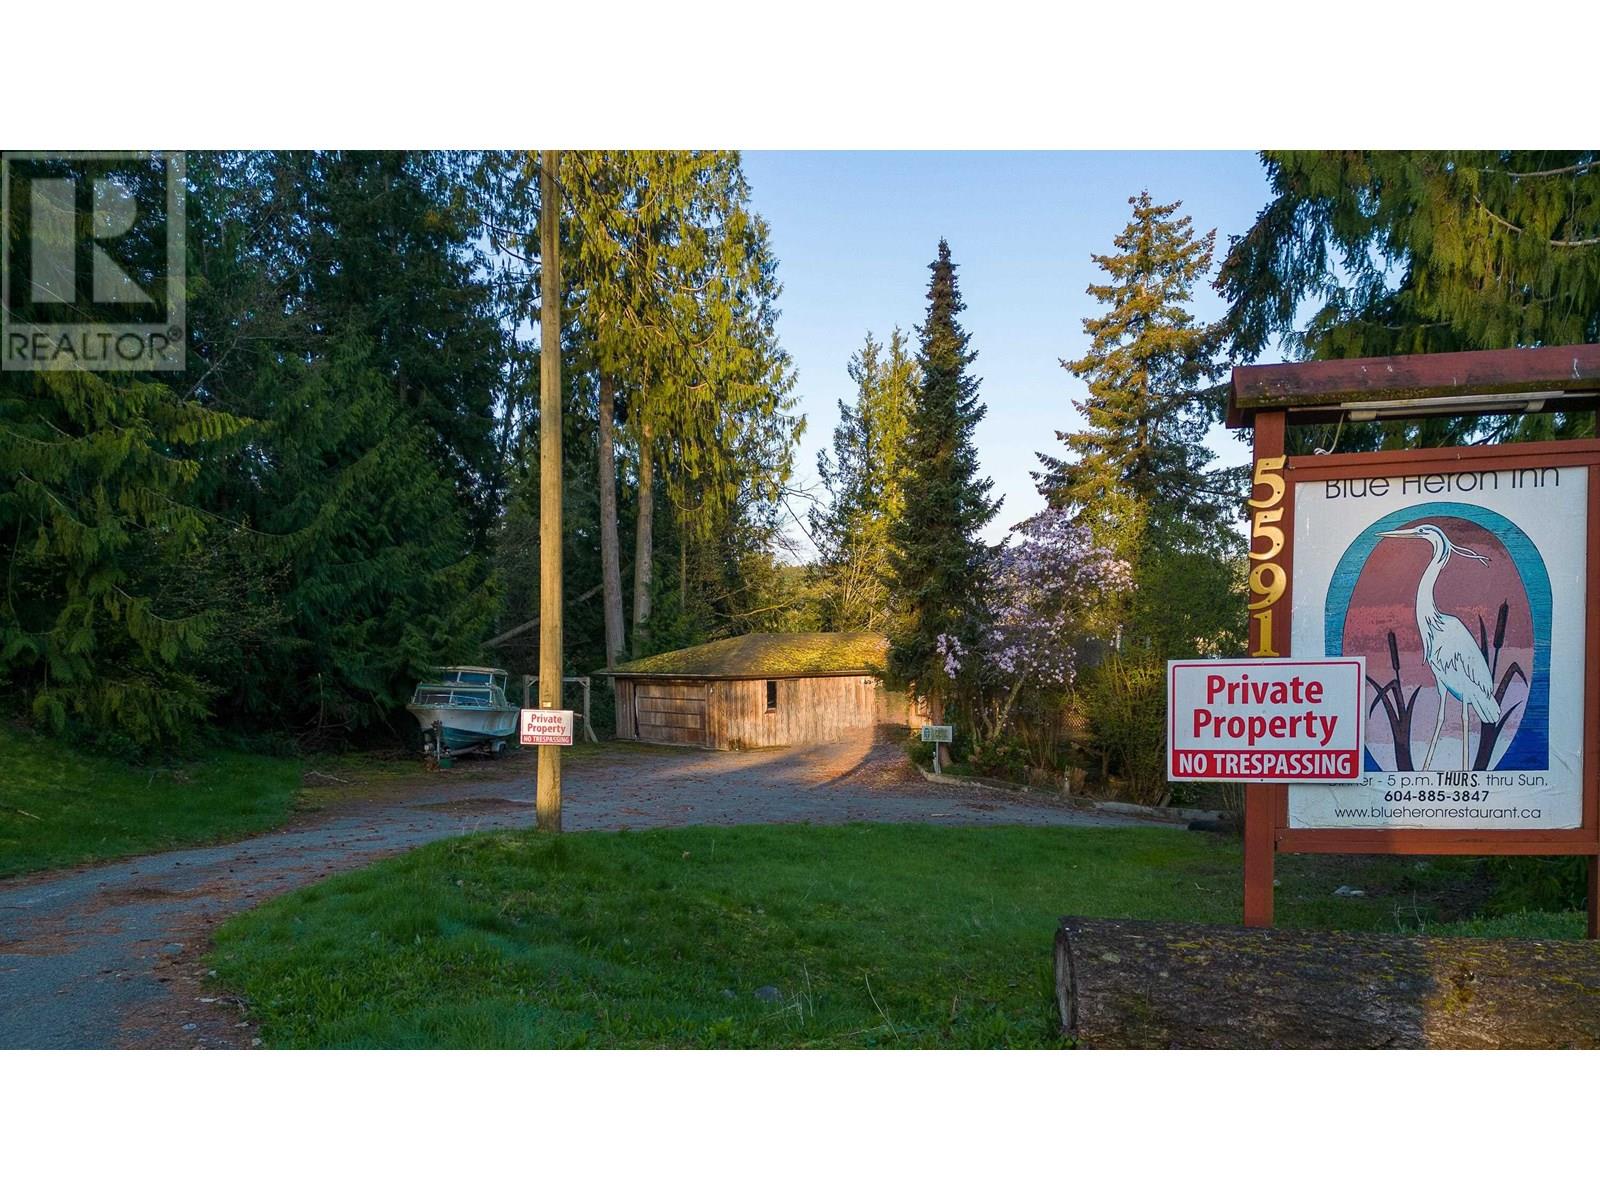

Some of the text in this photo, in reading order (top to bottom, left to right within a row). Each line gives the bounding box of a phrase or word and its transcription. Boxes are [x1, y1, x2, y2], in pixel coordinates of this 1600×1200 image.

[1325, 466, 1560, 499] Blue Heron Inn
[1248, 454, 1287, 657] 5591
[1206, 673, 1324, 705] Private
[531, 713, 562, 724] Private
[527, 723, 566, 735] Property
[1193, 708, 1338, 747] Property
[523, 735, 570, 744] NO TRESPASSING
[1179, 753, 1351, 775] NO TRESPASSING
[1387, 774, 1396, 787] 5
[1400, 775, 1434, 788] p.m.
[1486, 774, 1514, 787] thru
[1518, 774, 1549, 787] Sun.
[1384, 790, 1490, 802] 604-885-3847
[1334, 806, 1542, 819] www.blueheronrestaurant.ca
